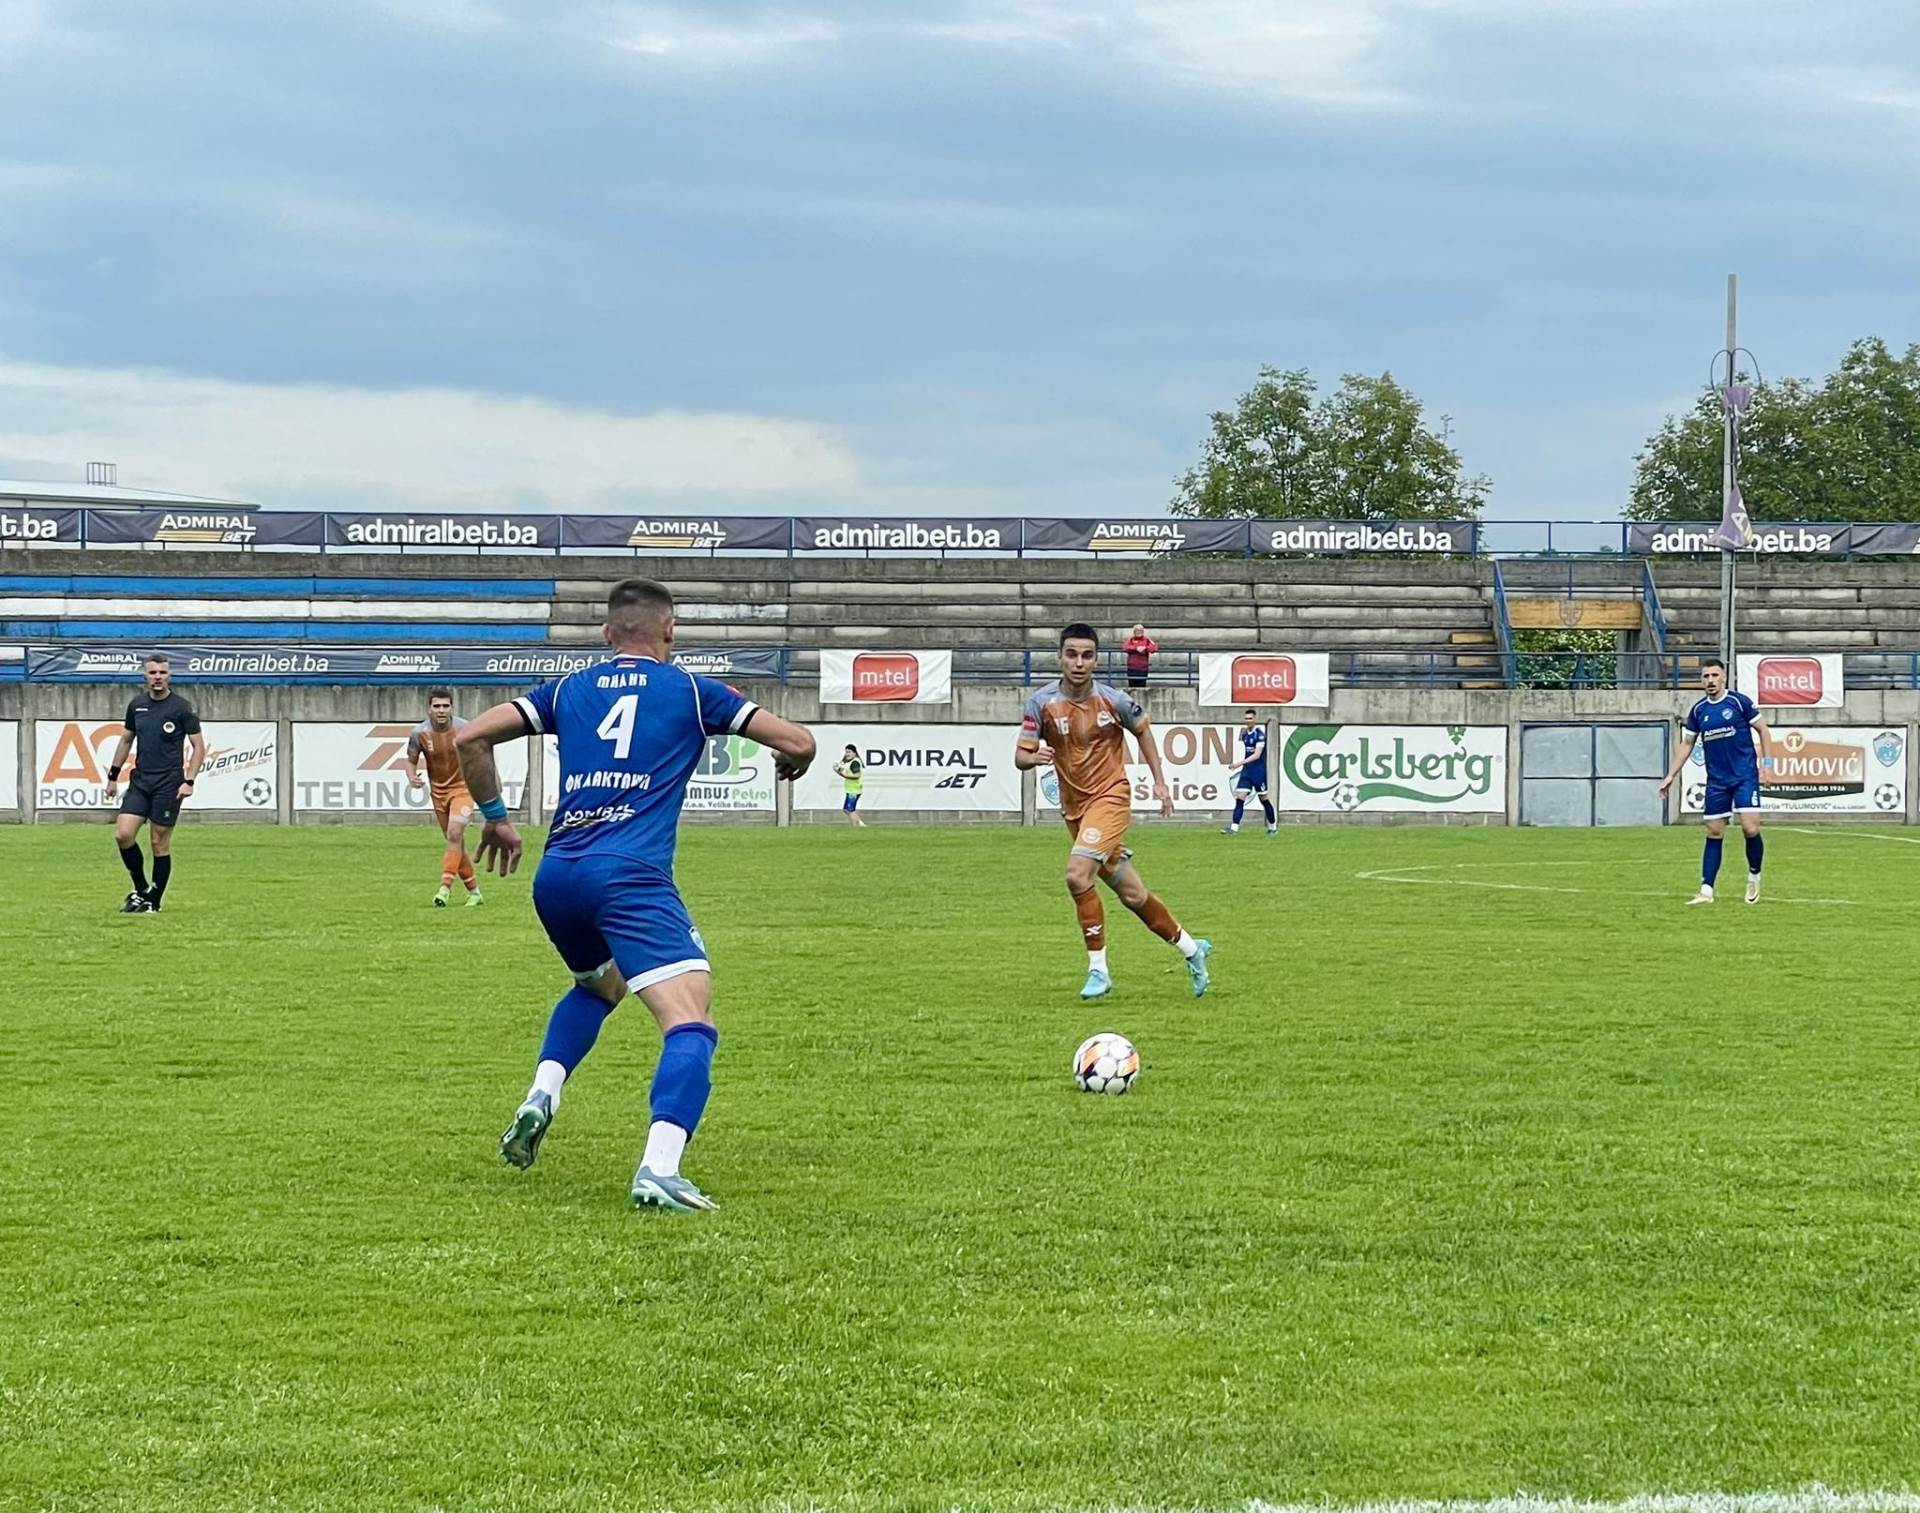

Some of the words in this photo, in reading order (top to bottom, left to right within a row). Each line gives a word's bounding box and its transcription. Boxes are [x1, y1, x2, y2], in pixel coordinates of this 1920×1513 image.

[0, 513, 58, 538] t.ba
[160, 514, 256, 531] ADMIRAL
[347, 518, 538, 545] admiralbet.ba
[632, 520, 726, 536] ADMIRAL
[1093, 523, 1185, 539] ADMIRAL
[221, 531, 256, 542] BET
[692, 536, 725, 548] BET
[814, 523, 1000, 548] admiralbet.ba
[1152, 538, 1185, 550] BET
[1271, 525, 1452, 550] admiralbet.ba
[80, 653, 142, 663] ADMIRAL
[188, 654, 329, 672] admiralbet.ba
[379, 655, 440, 665] ADMIRAL
[673, 655, 732, 665] ADMIRAL
[859, 666, 911, 687] m:tel
[1238, 671, 1288, 689] m:tel
[1764, 674, 1815, 690] m:tel
[596, 694, 639, 759] 4
[1054, 716, 1069, 735] 16
[199, 743, 274, 772] ovanović
[866, 748, 987, 769] DMIRAL
[1283, 725, 1493, 794] Carlsberg
[1774, 752, 1859, 776] UMOVIĆ
[935, 774, 986, 788] BET
[732, 787, 772, 799] Petrol
